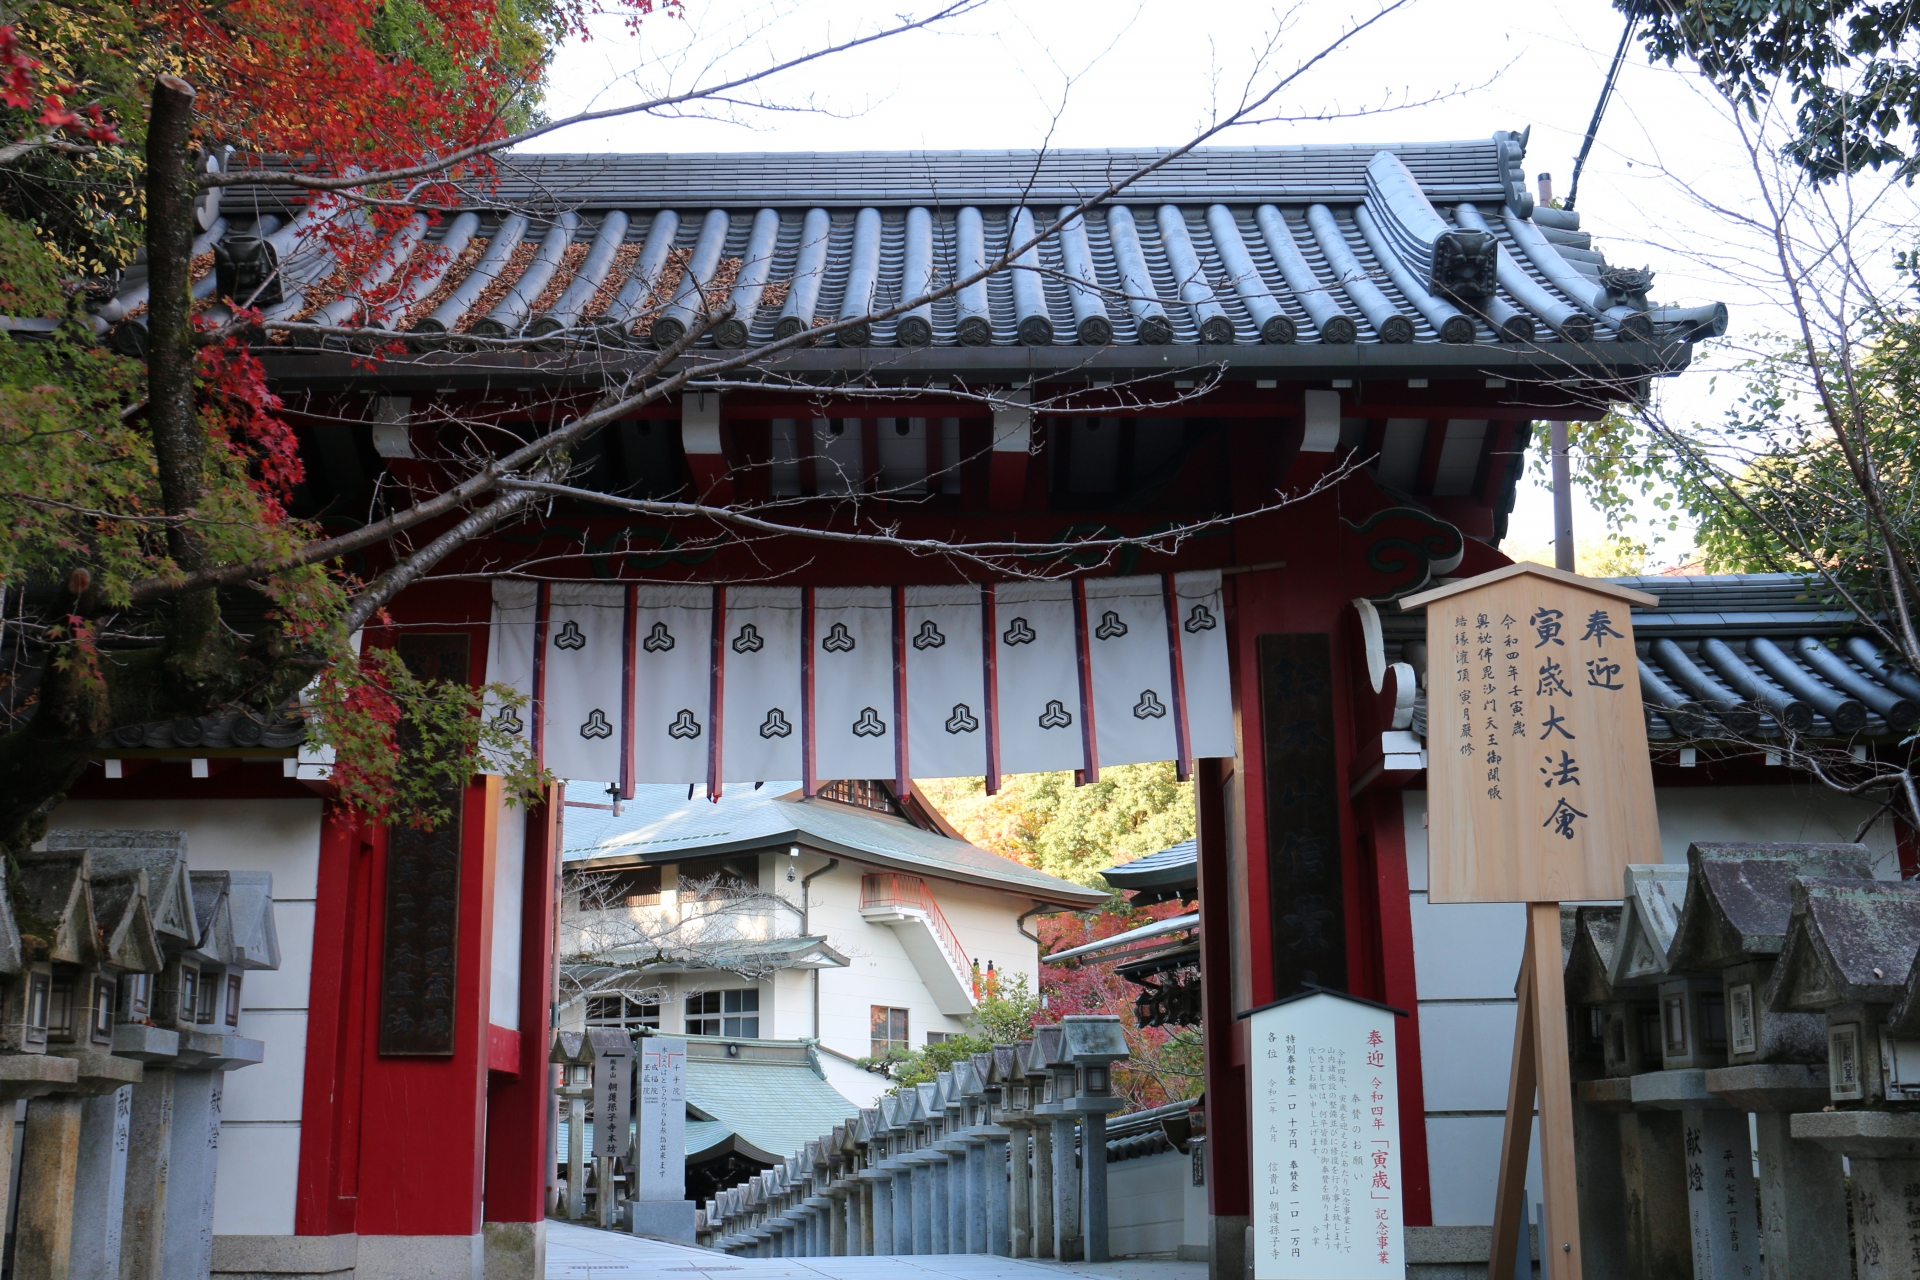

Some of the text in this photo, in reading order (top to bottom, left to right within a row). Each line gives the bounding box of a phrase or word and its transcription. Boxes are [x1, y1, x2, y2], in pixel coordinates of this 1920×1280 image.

[1580, 609, 1625, 691] 奉迎
[1285, 1034, 1296, 1086] 特別奉賛金
[1366, 1029, 1385, 1068] 奉迎
[672, 1063, 681, 1095] 千手院
[606, 1081, 618, 1154] 朝護孫子寺本坊
[1267, 1032, 1280, 1260] 各位 令和二年 九月 信貴山 朝護孫子寺
[1288, 1117, 1297, 1149] 十万円
[1350, 1093, 1363, 1180] 奉賛のお願い
[1289, 1160, 1299, 1192] 奉賛金
[1686, 1127, 1704, 1192] 献燈
[1722, 1149, 1740, 1253] 平成七年一月吉日
[1290, 1228, 1300, 1258] 一万円
